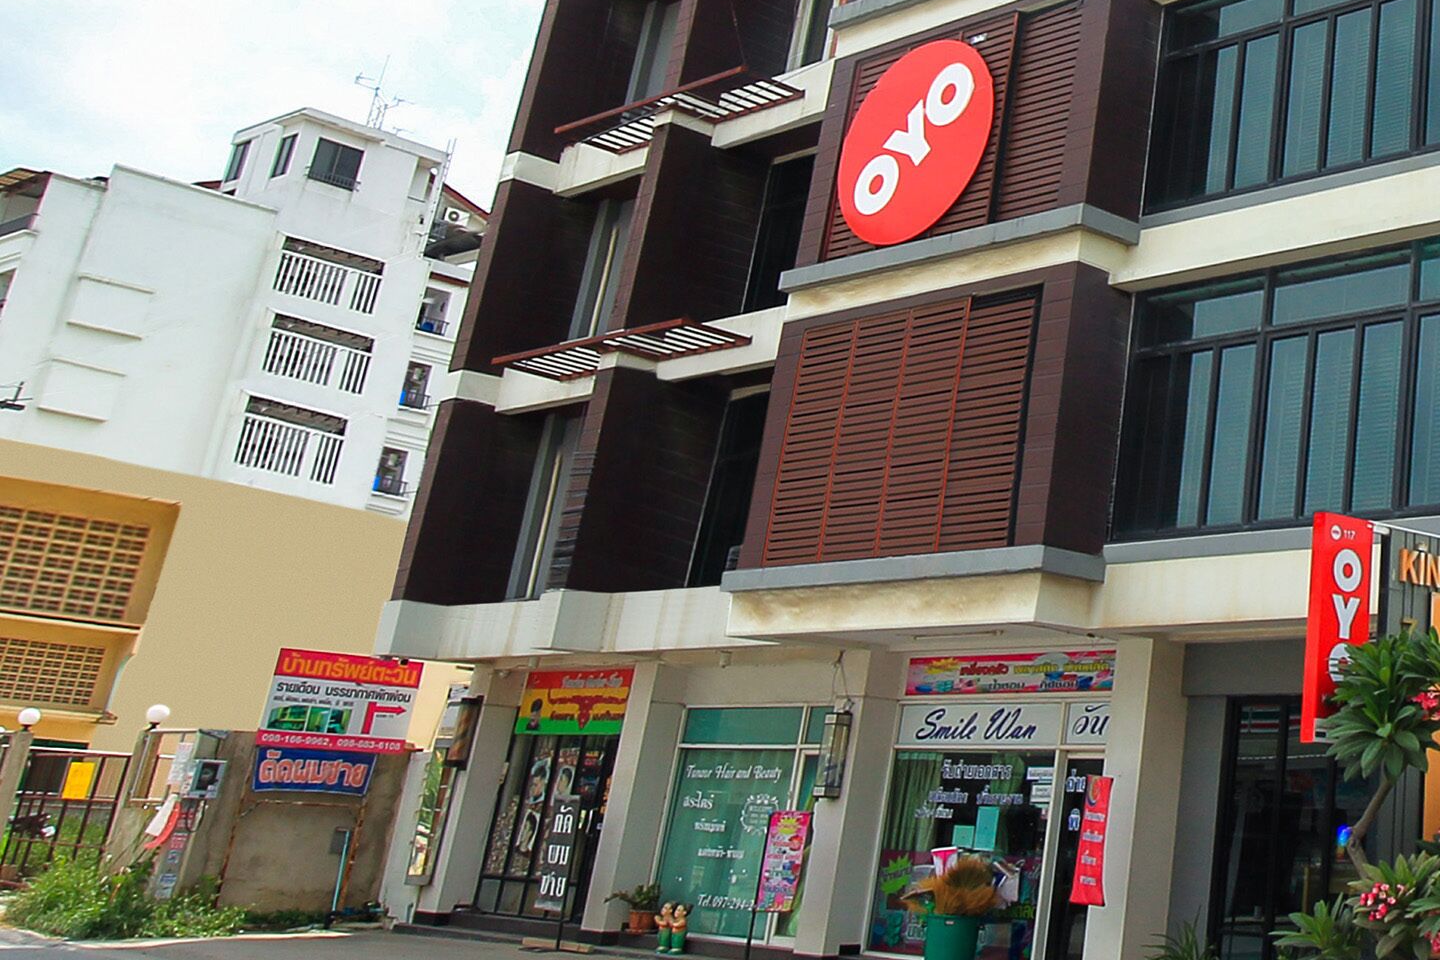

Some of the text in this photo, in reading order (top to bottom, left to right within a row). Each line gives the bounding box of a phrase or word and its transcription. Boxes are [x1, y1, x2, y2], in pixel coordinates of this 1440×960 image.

[854, 62, 975, 216] OYO
[282, 652, 419, 685] บ้านทรัพย์ตะวัน
[276, 680, 321, 695] รายเดือน
[325, 686, 412, 703] บรรยากาศพักผ่อน
[915, 707, 1037, 740] Smile Wan
[258, 749, 369, 788] ตัดผมชาย
[715, 762, 735, 779] Hair
[735, 765, 752, 779] and
[753, 764, 783, 783] Beauty
[941, 758, 1013, 780] รับถ่ายเอกสาร
